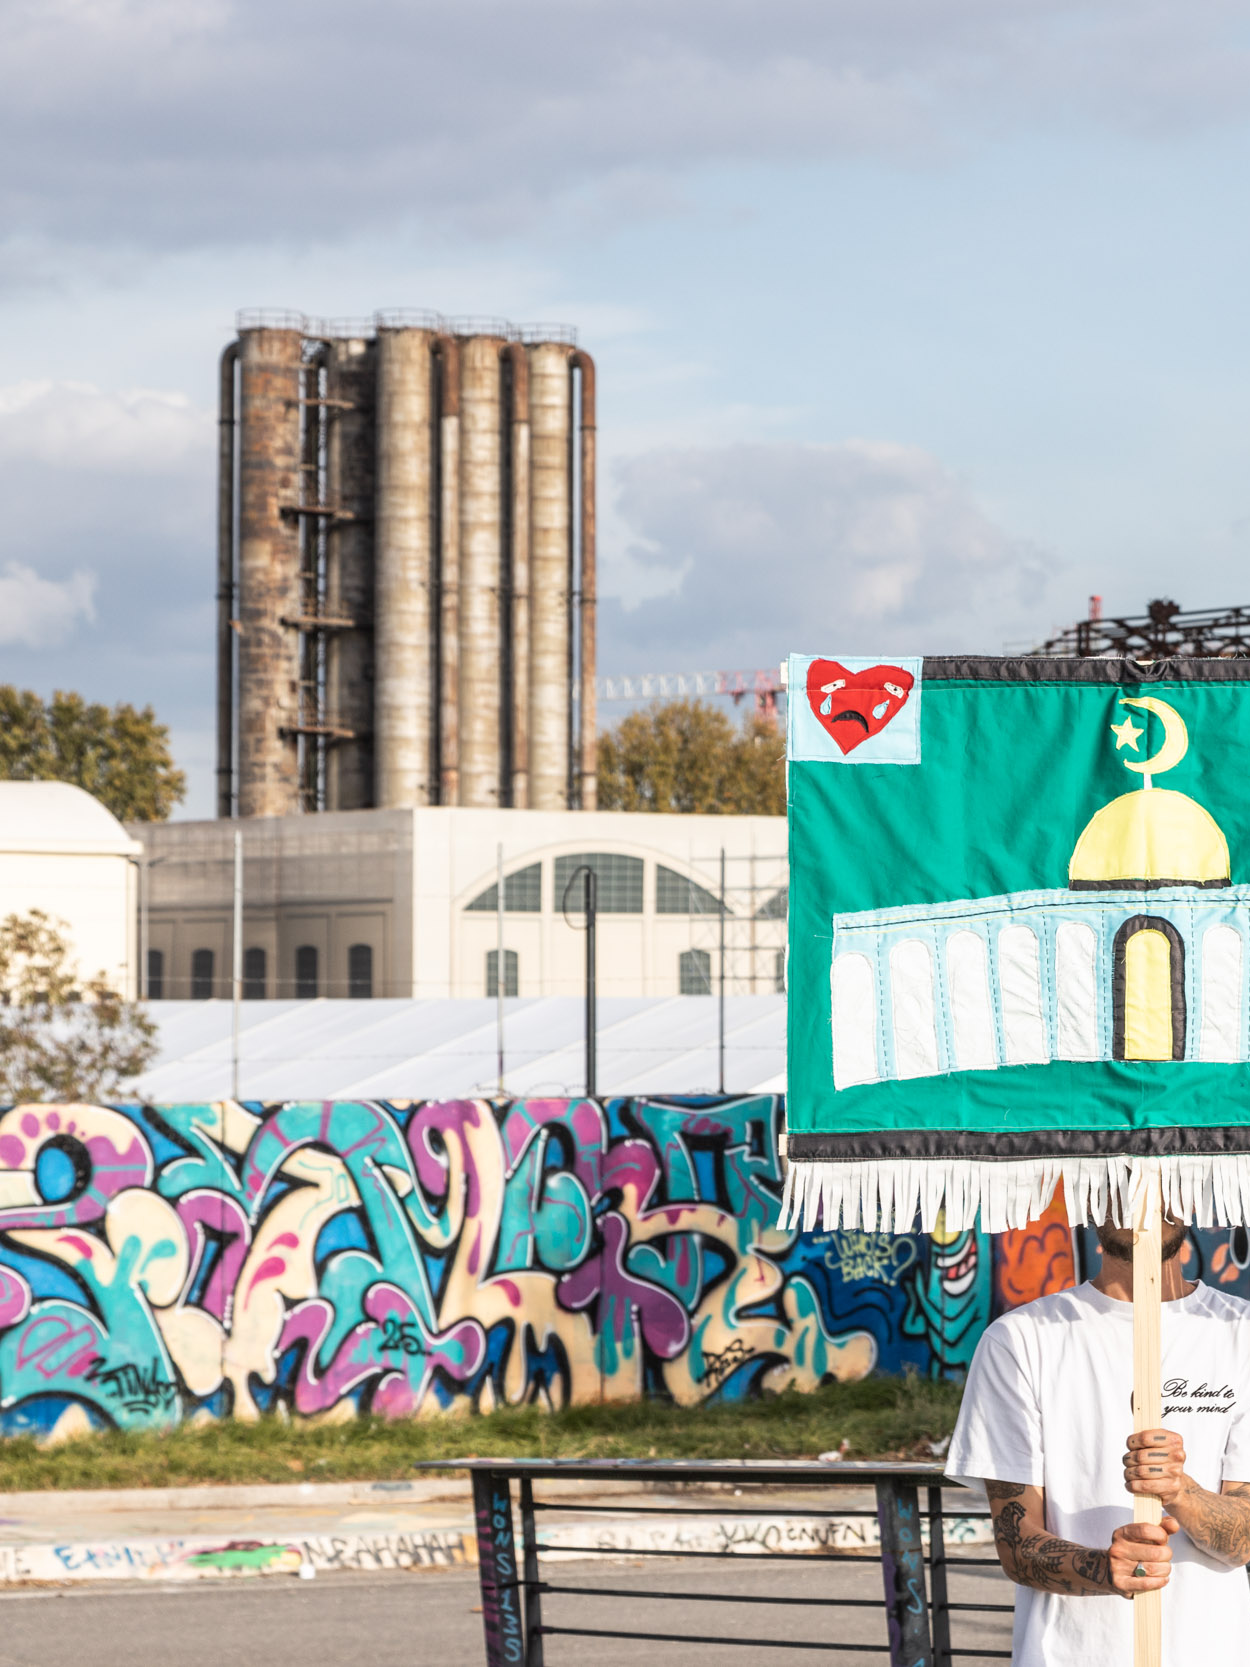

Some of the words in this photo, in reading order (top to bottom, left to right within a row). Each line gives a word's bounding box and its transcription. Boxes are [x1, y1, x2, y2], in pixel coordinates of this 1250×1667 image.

[1161, 1378, 1189, 1398] Be
[1190, 1382, 1229, 1398] kind
[1223, 1388, 1235, 1399] to
[1161, 1405, 1193, 1418] your
[1196, 1401, 1237, 1413] mind
